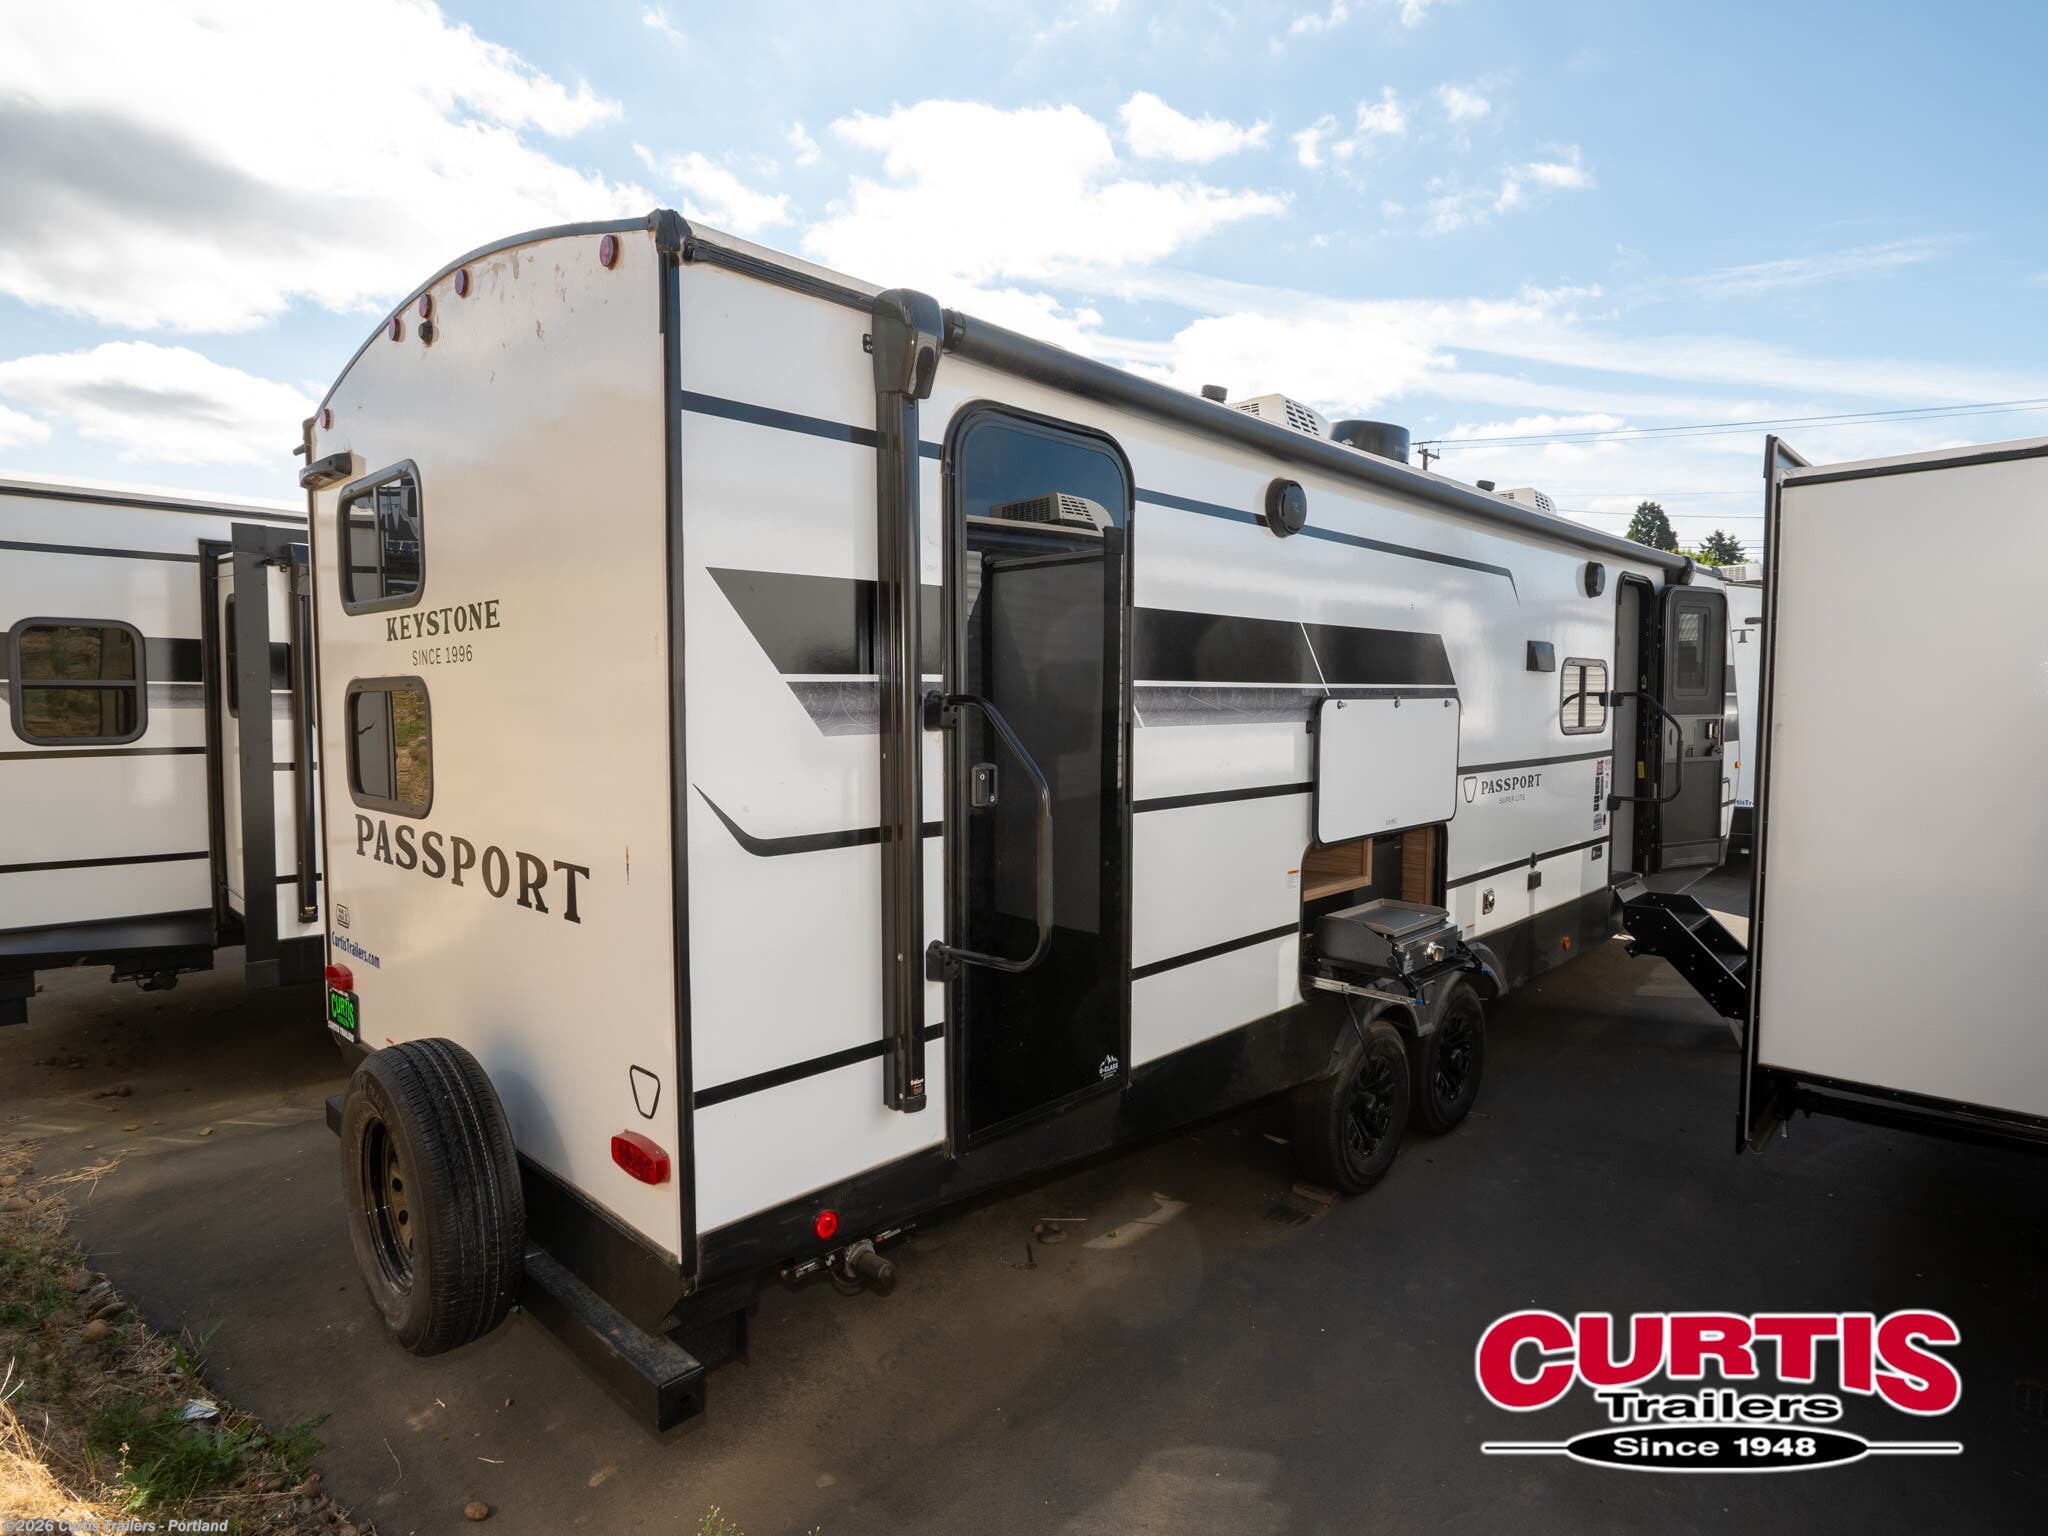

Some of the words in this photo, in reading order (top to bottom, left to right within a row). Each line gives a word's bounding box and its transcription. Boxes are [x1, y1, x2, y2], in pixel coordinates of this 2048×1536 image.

[386, 599, 500, 642] KEYSTONE
[412, 647, 442, 667] SINCE
[445, 644, 473, 664] 1996
[1481, 773, 1542, 795] PASSPORT
[355, 813, 590, 924] PASSPORT
[331, 931, 381, 969] CurtisTrailers.com
[331, 993, 355, 1029] CURTIS
